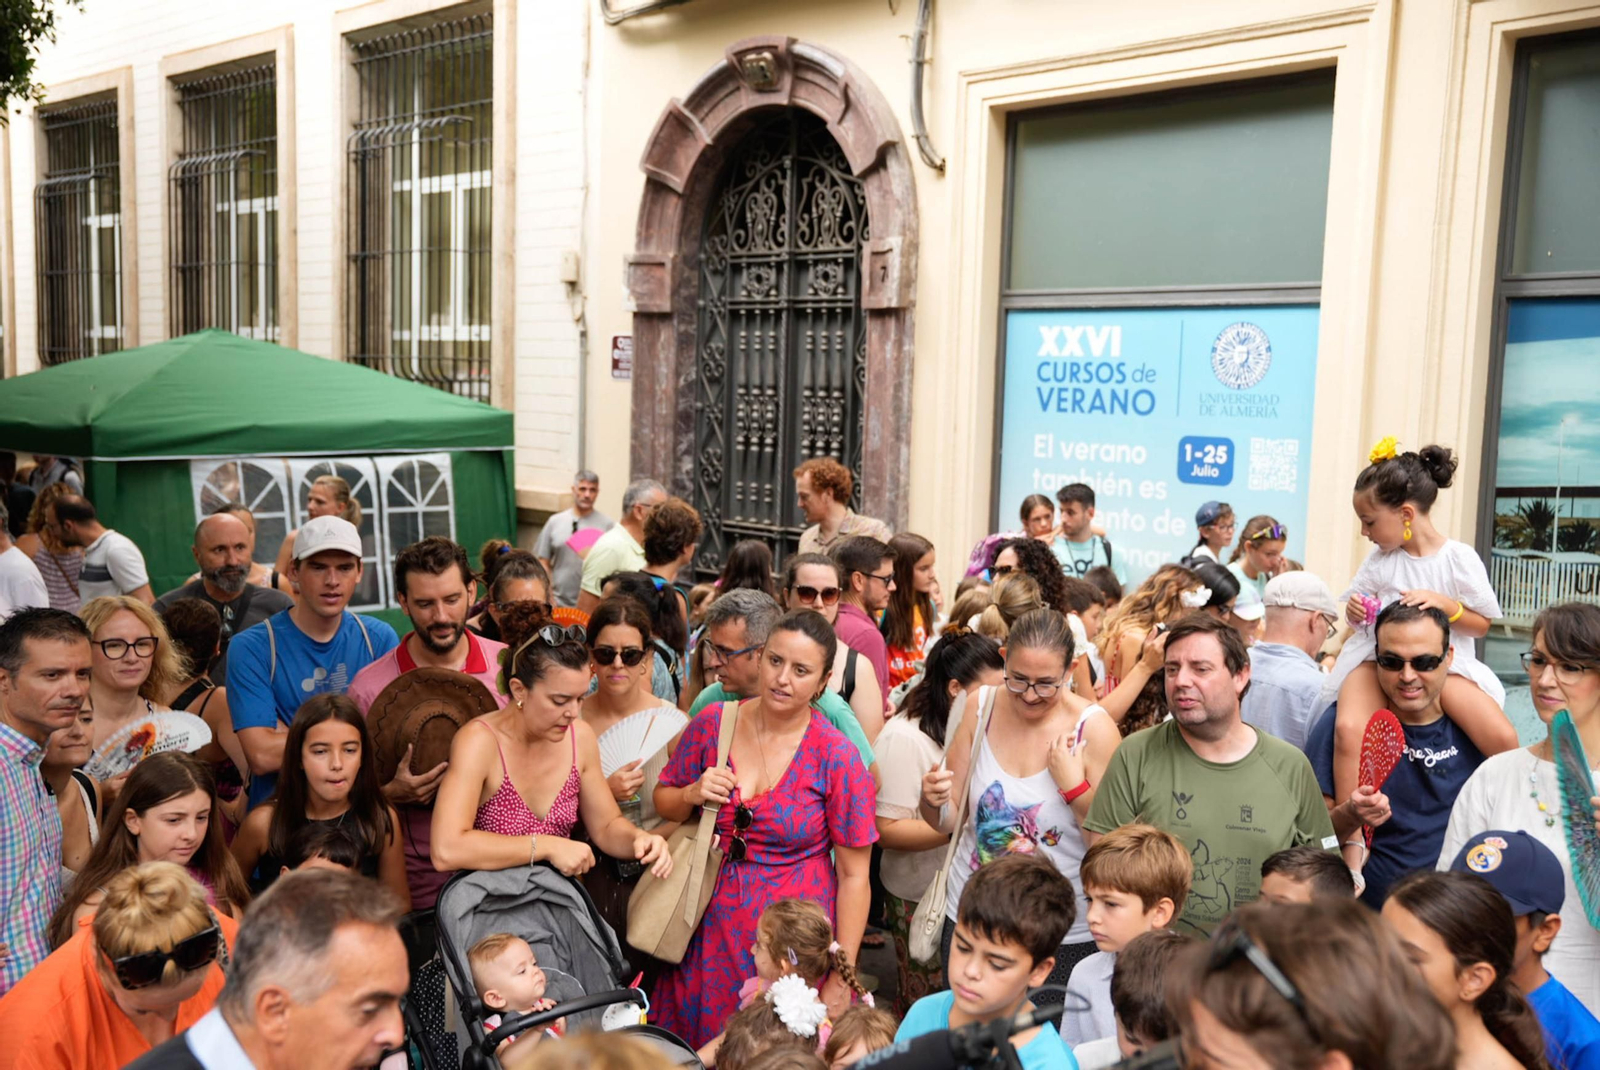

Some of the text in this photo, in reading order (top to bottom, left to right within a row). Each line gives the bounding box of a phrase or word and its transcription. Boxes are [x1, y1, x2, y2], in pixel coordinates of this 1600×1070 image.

[880, 266, 888, 283] 7
[1037, 325, 1122, 357] XXVI
[1036, 361, 1157, 384] CURSOS de
[1036, 386, 1156, 416] VERANO
[1199, 392, 1280, 406] UNIVERSIDAD
[1199, 404, 1279, 419] DE ALMERÍA
[1034, 433, 1147, 464] El verano
[1190, 464, 1219, 478] Julio
[1138, 480, 1168, 500] es
[1152, 508, 1186, 536] de
[1403, 744, 1425, 762] epe
